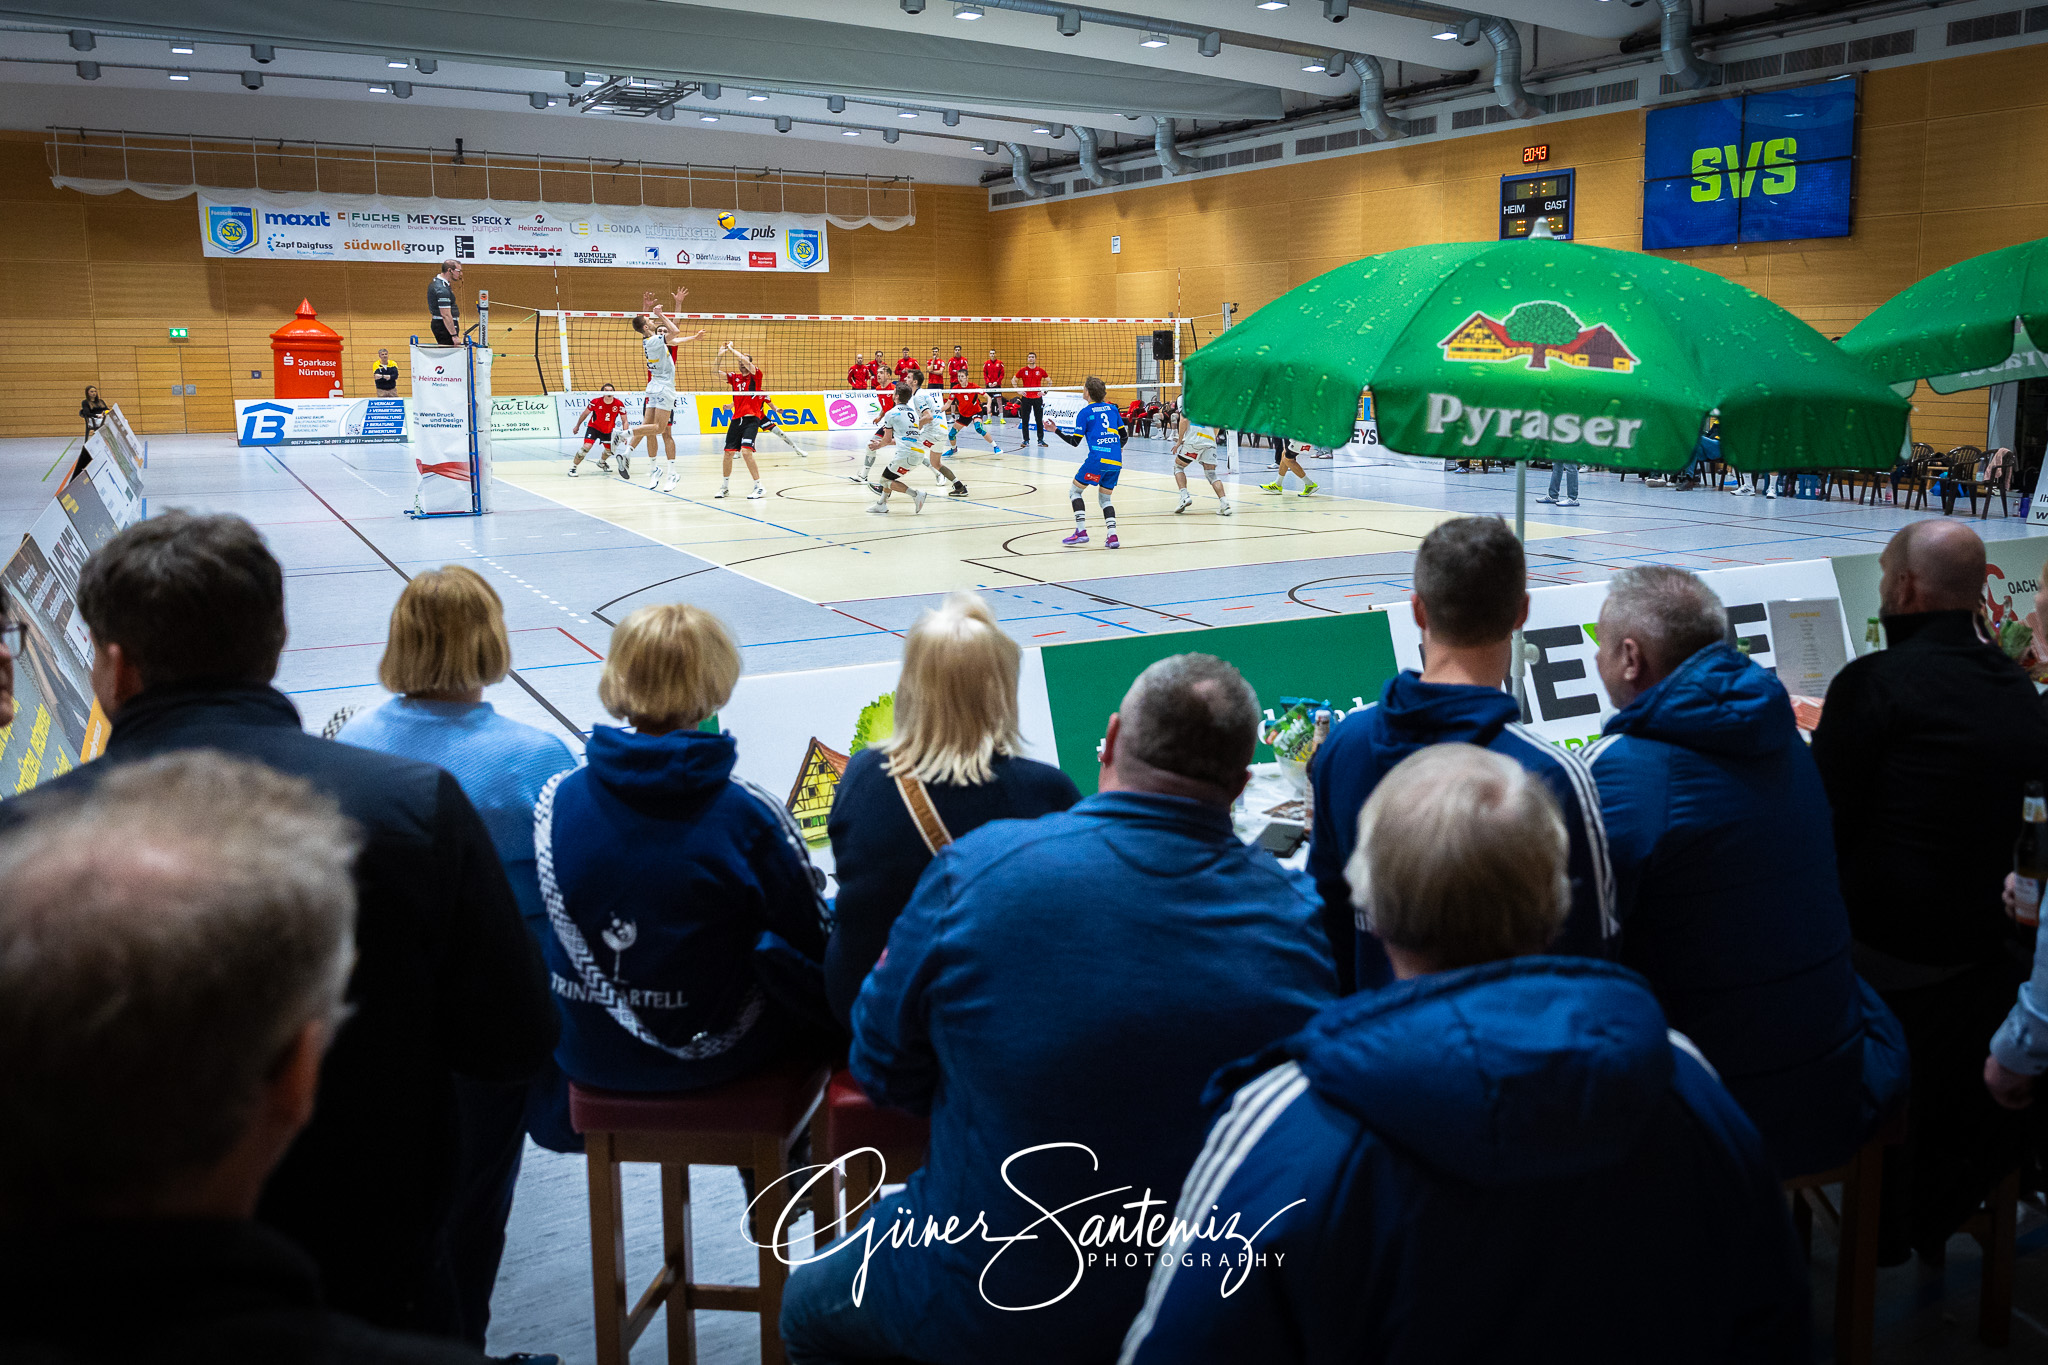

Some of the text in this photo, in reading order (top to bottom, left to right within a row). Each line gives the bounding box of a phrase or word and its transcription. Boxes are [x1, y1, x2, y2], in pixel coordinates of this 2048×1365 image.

[1523, 145, 1547, 162] 20:43
[1691, 137, 1797, 203] SVS
[1503, 204, 1525, 215] HEIM
[1544, 200, 1567, 210] GAST
[265, 211, 330, 227] maxit
[351, 212, 400, 222] FUCHS
[407, 213, 466, 226] MEYSEL
[471, 216, 502, 225] SPECK
[371, 222, 400, 230] umsetzen
[472, 225, 503, 233] pumpen
[518, 224, 562, 232] Heinzelmann
[597, 223, 641, 234] LEONDA
[275, 241, 334, 250] Zapf Daigfuss
[298, 358, 337, 368] Sparkasse
[298, 368, 336, 378] Nürnberg
[515, 400, 549, 411] Elia
[604, 413, 611, 421] 2
[907, 411, 916, 424] 9
[1101, 412, 1110, 429] 3
[1425, 392, 1643, 449] Pyraser
[1351, 428, 1377, 445] EYS
